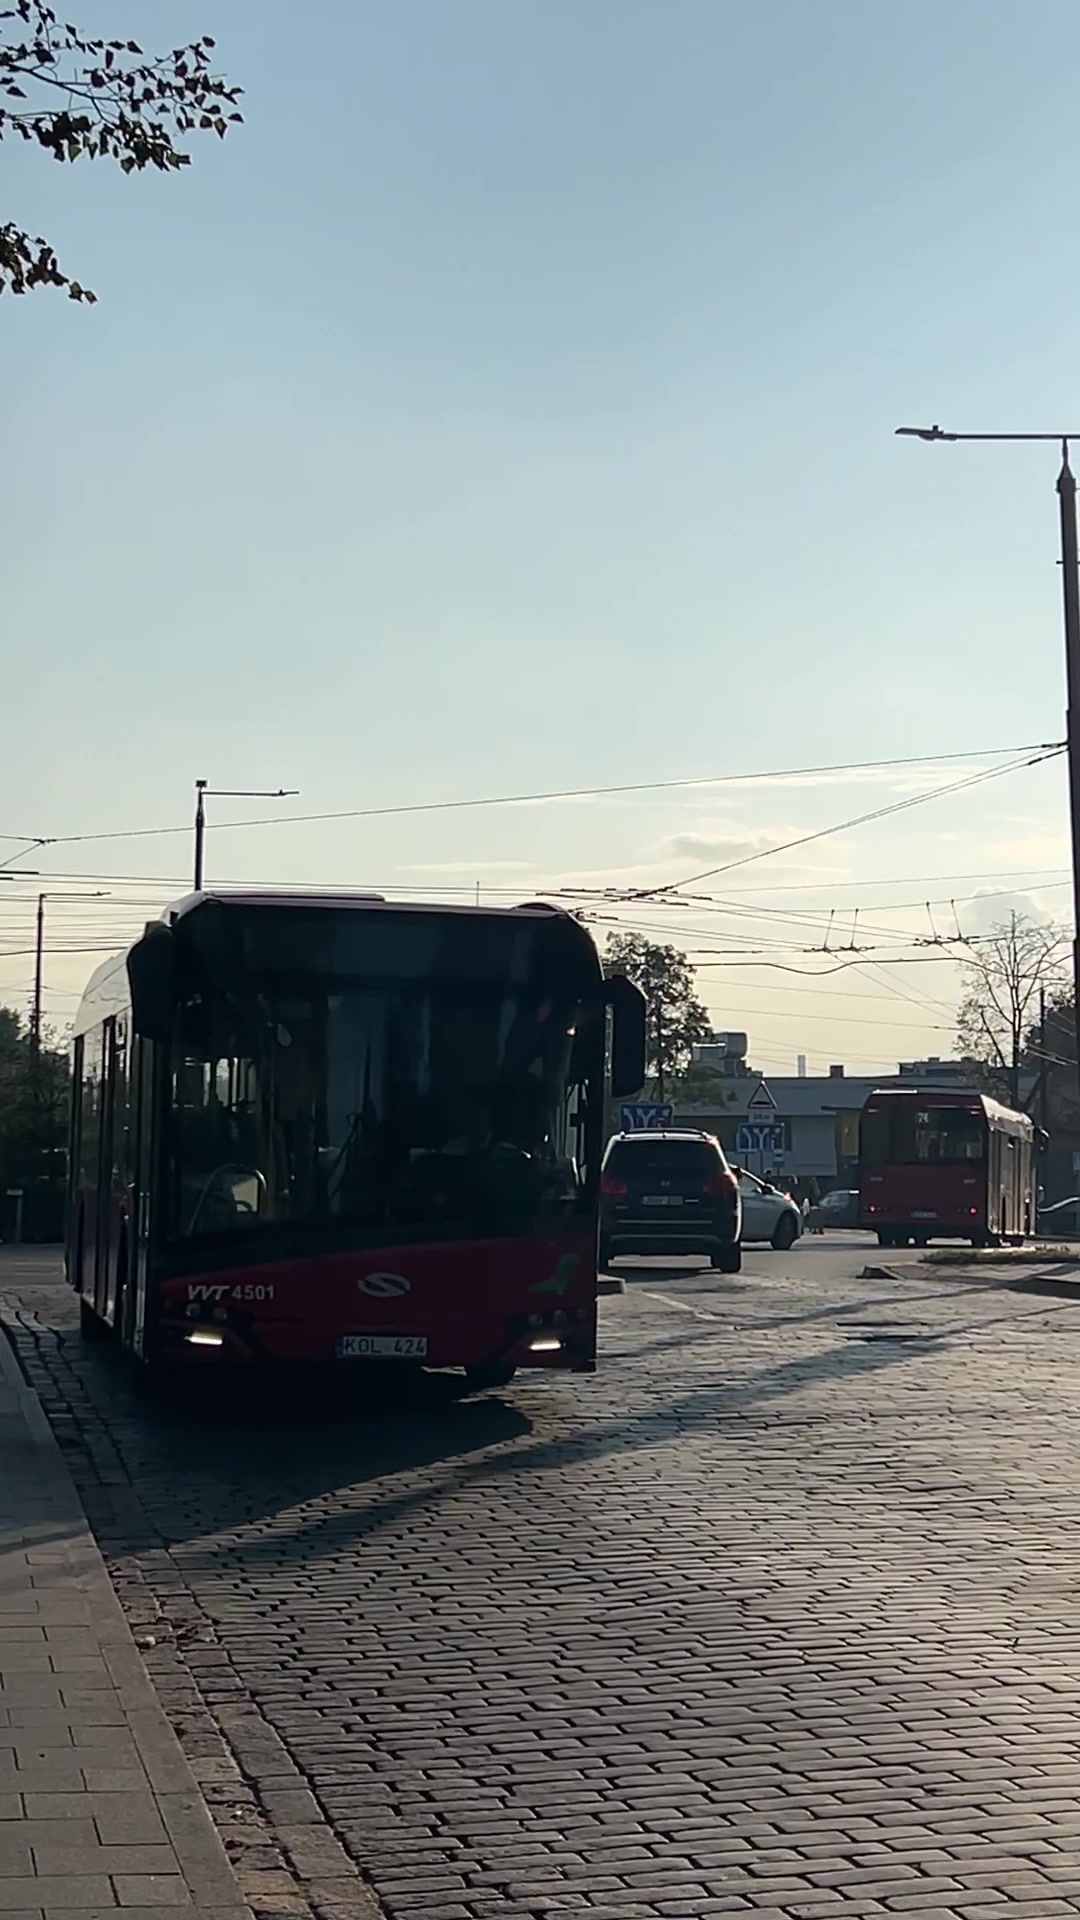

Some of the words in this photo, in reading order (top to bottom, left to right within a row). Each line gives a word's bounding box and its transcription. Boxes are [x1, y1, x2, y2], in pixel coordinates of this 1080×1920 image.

[188, 1285, 230, 1301] VVT
[231, 1284, 274, 1300] 4501
[345, 1338, 382, 1354] KOL
[394, 1338, 425, 1354] 424
